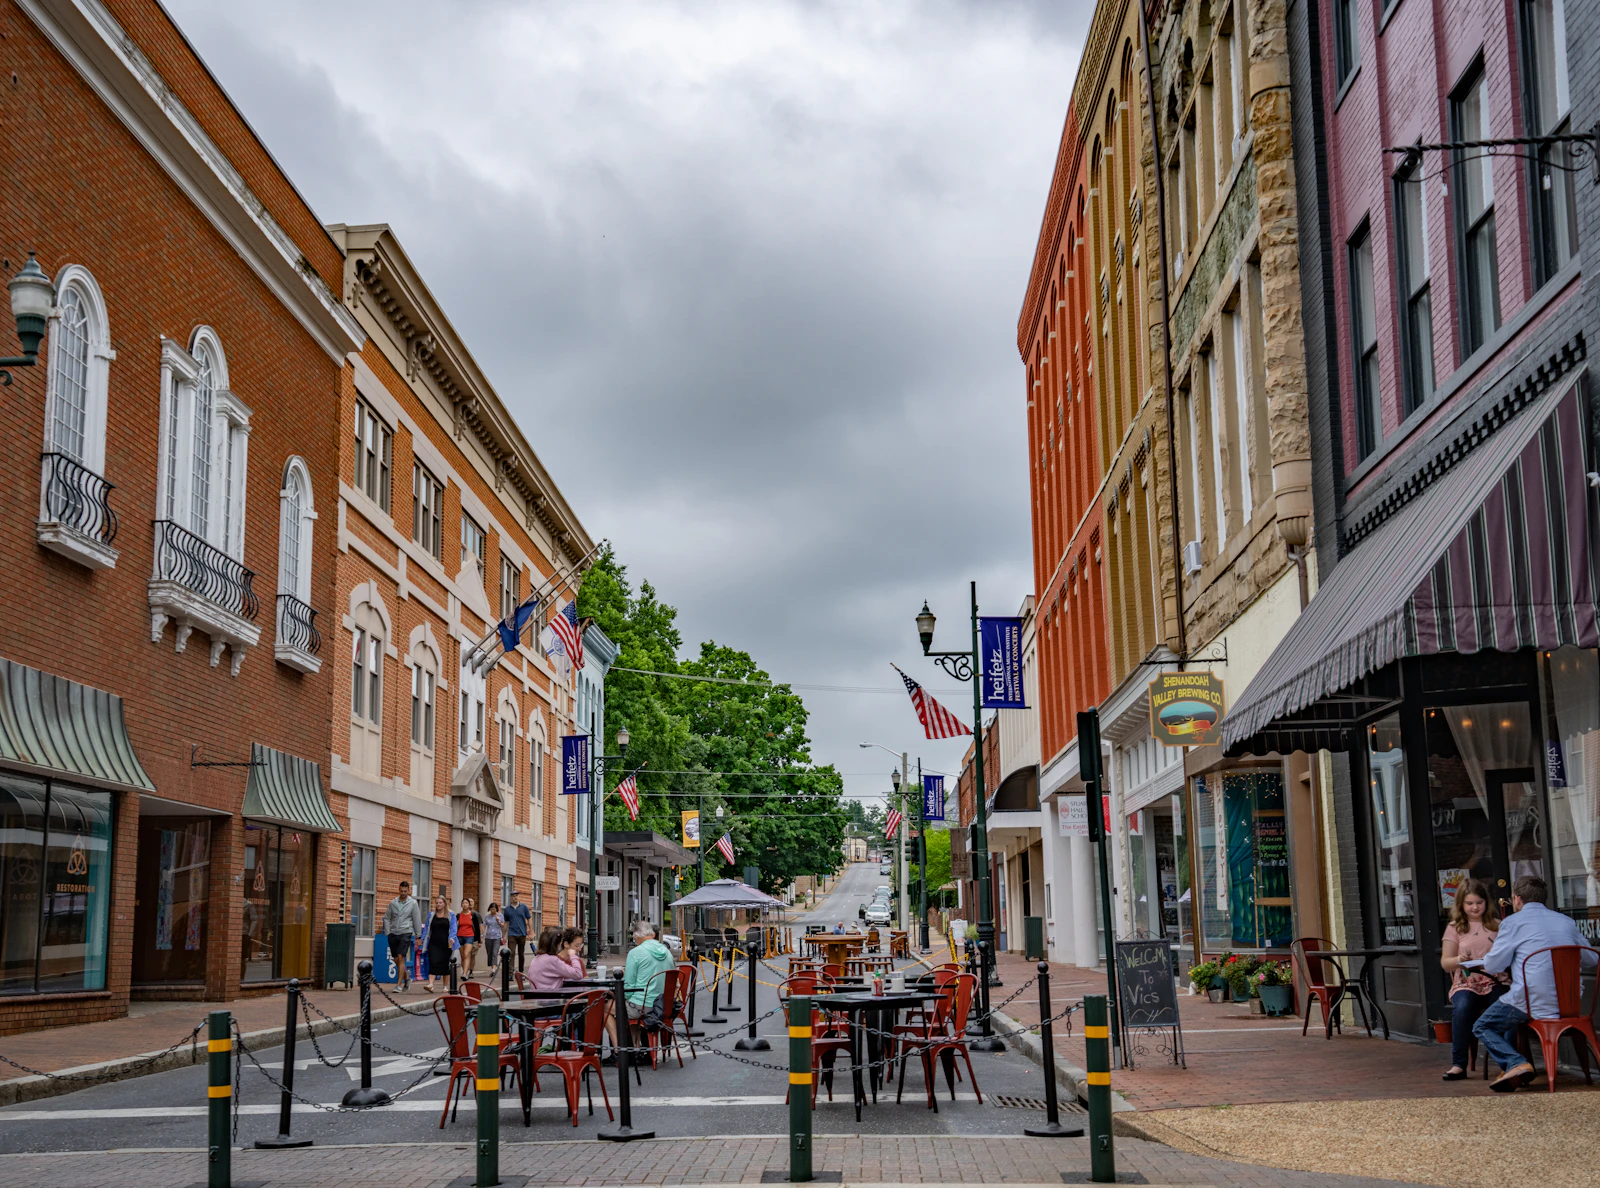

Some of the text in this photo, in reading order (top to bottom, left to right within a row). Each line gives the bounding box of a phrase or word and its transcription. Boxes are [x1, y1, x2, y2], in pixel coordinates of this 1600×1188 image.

[988, 649, 1004, 701] heifetz
[1013, 662, 1019, 671] OF
[1013, 671, 1021, 701] FESTIVAL
[1163, 675, 1209, 688] SHENANDOAH
[1153, 688, 1223, 708] VALLEY BREWING CO.
[566, 755, 576, 789] heifetz
[926, 790, 935, 816] heifetz
[56, 883, 95, 893] RESTORATION
[1138, 970, 1154, 984] To
